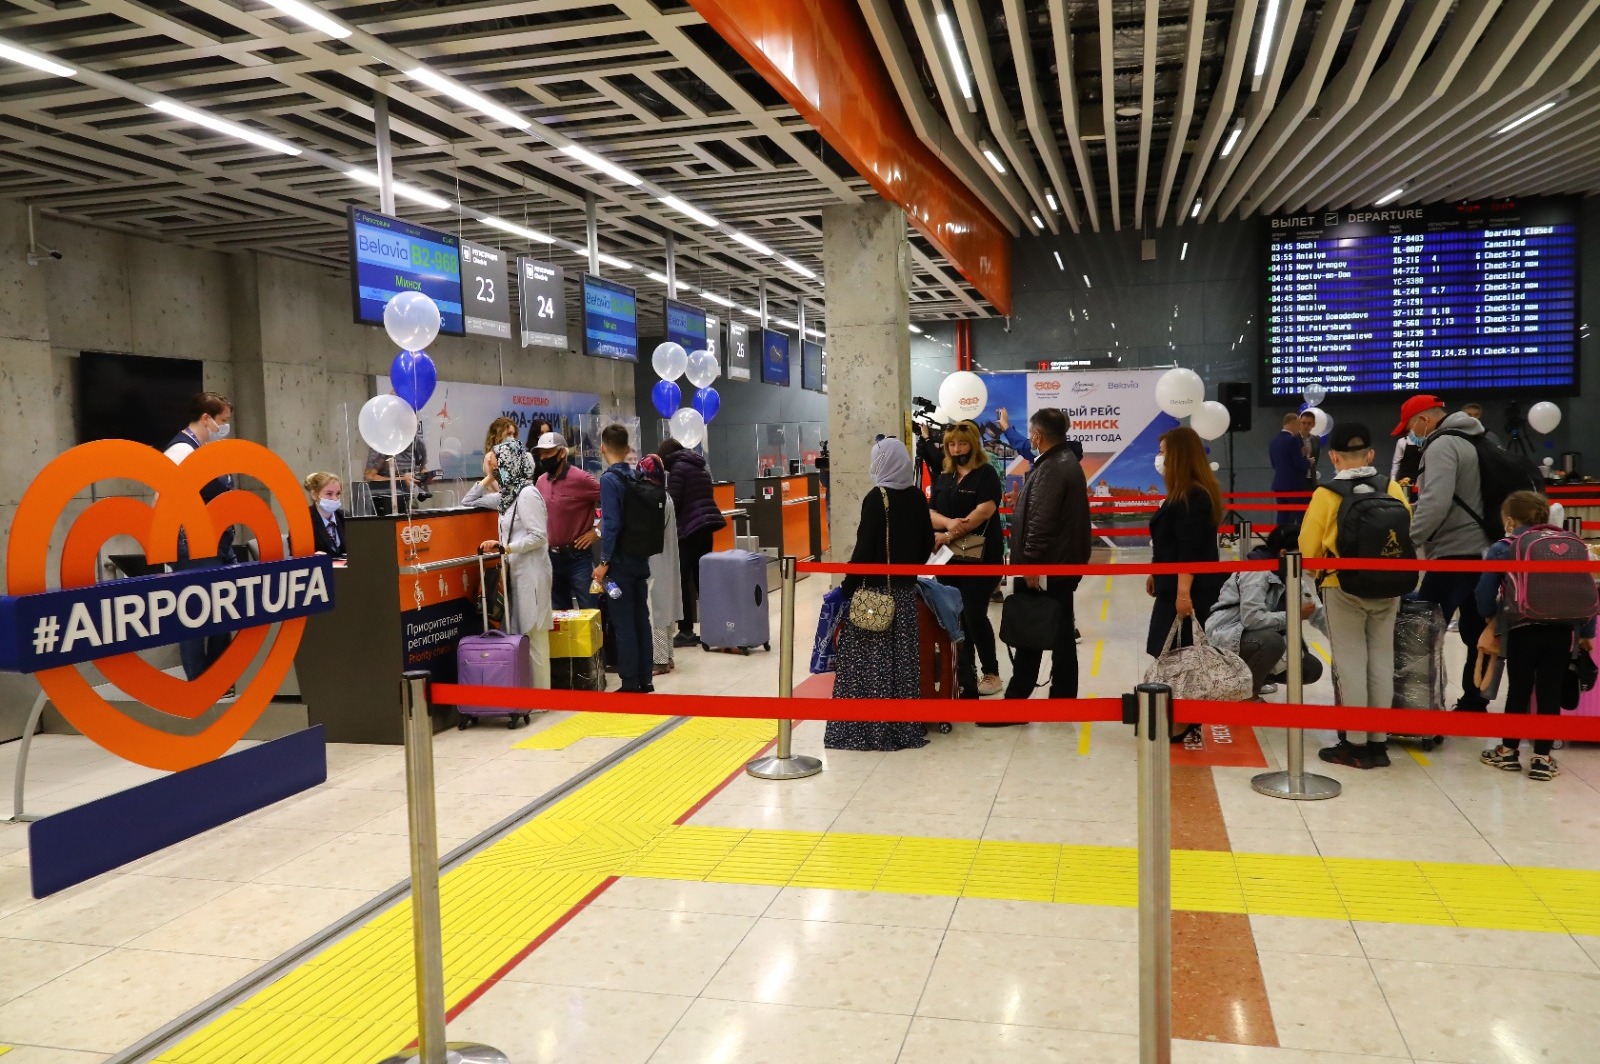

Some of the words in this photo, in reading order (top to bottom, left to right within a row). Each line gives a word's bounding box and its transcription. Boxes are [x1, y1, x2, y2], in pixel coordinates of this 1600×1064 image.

[1271, 216, 1315, 229] ВЫЛЕТ
[1348, 208, 1424, 224] DEPARTURE
[1271, 243, 1293, 251] 03:45
[1296, 241, 1317, 250] Sochi
[1484, 229, 1521, 238] Boarding
[1524, 226, 1554, 235] Closed
[359, 235, 408, 261] Belavia
[1271, 253, 1293, 261] 03:55
[1296, 251, 1327, 260] Antalya
[1484, 239, 1526, 248] Cancelled
[1271, 263, 1293, 272] 04:15
[1296, 263, 1313, 271] Novy
[1317, 261, 1347, 269] Urengoy
[1431, 254, 1437, 262] 4
[1272, 273, 1293, 282] 04:40
[1296, 271, 1351, 280] Rostov-on-Don
[1432, 265, 1440, 273] 11
[1272, 284, 1293, 292] 04:45
[1296, 283, 1317, 291] Sochi
[1484, 271, 1526, 281] Cancelled
[395, 274, 422, 292] Минск
[475, 276, 495, 304] 23
[1272, 294, 1293, 303] 04:45
[1296, 293, 1317, 302] Sochi
[1475, 284, 1481, 292] 7
[537, 295, 555, 319] 24
[1272, 304, 1293, 313] 04:55
[1296, 303, 1327, 312] Antalya
[1484, 293, 1526, 302] Cancelled
[1272, 315, 1294, 323] 05:15
[1297, 314, 1323, 322] Moscow
[1325, 312, 1369, 321] Domodedovo
[1475, 305, 1481, 313] 2
[1272, 325, 1294, 333] 05:25
[1296, 323, 1352, 332] St.Petersburg
[1432, 317, 1455, 326] 12,13
[1475, 316, 1481, 324] 9
[1272, 335, 1294, 344] 05:40
[1297, 334, 1323, 343] Moscow
[1431, 328, 1437, 336] 3
[736, 341, 745, 358] 26
[1272, 356, 1294, 364] 06:20
[1296, 355, 1318, 363] Minsk
[1472, 348, 1481, 356] 14
[1296, 344, 1352, 353] St.Petersburg
[1317, 365, 1348, 373] Urengoy
[1108, 380, 1139, 390] Belavia
[1325, 374, 1356, 382] Vnukovo
[1090, 404, 1121, 416] РЕЙС
[1073, 434, 1093, 442] 2021
[1095, 434, 1122, 442] ГОДА
[32, 565, 329, 655] #AIRPORTUFA
[406, 612, 464, 637] Приоритетная
[407, 626, 459, 652] регистрация
[408, 649, 433, 664] Priority
